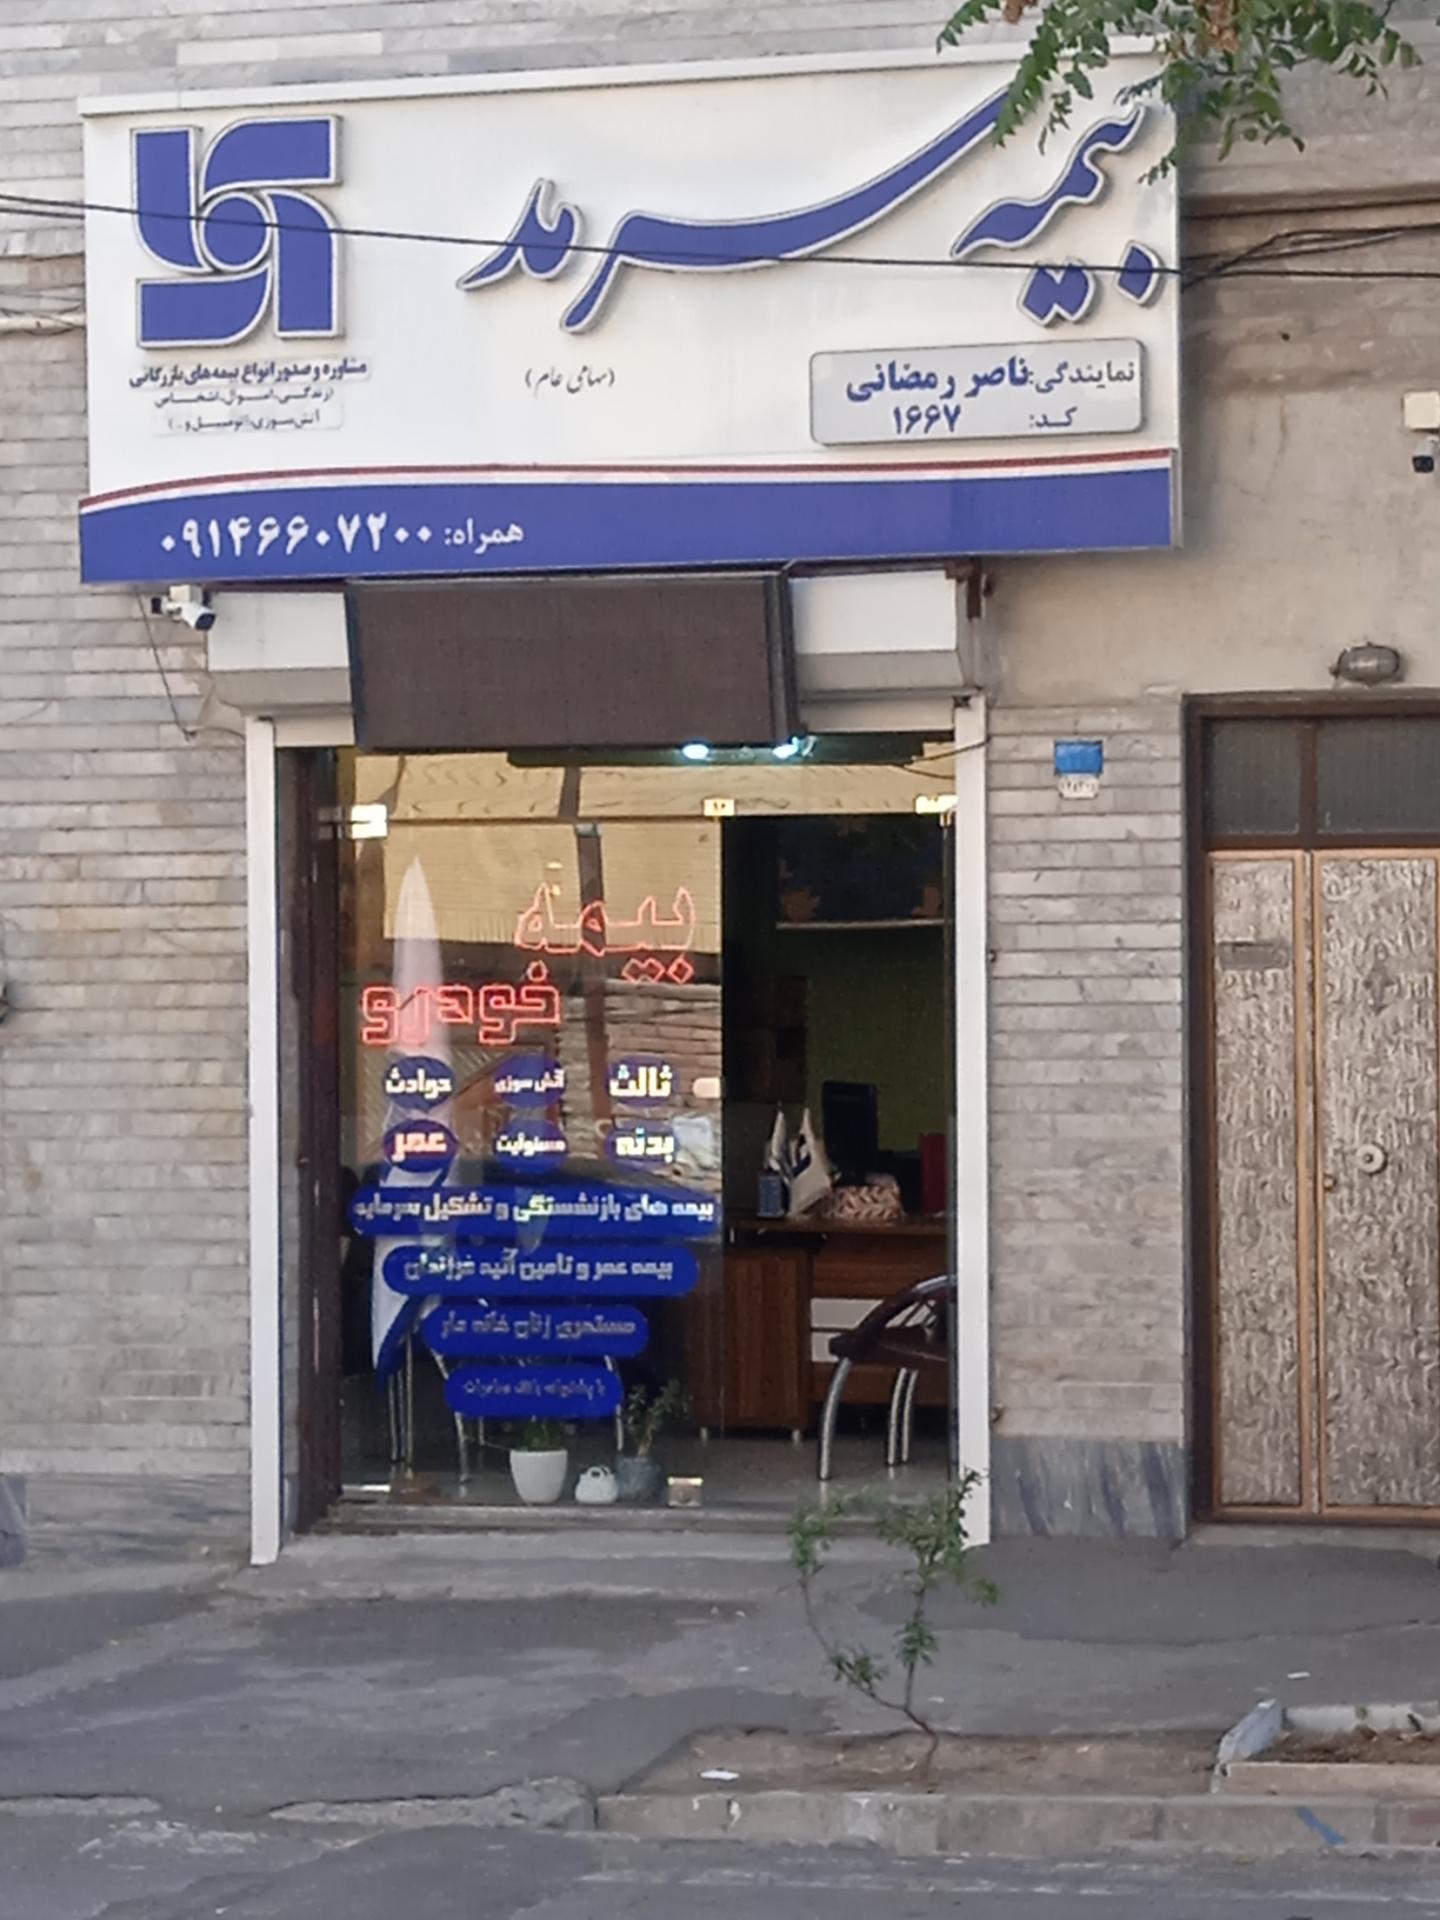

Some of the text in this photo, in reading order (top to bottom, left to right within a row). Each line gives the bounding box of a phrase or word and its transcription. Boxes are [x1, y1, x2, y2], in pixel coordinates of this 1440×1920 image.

[847, 361, 956, 402] رمضانی
[964, 356, 1029, 398] ناصر
[893, 403, 961, 434] ۱۶۶۷
[161, 511, 524, 558] همراه: ۰۹۱۴۶۶۰۷۲۰۰
[513, 881, 696, 983] بیمه
[362, 960, 561, 1044] خودرو
[385, 1068, 452, 1099] حوادث
[609, 1065, 673, 1098] ثالث
[391, 1132, 448, 1162] عمر
[616, 1127, 675, 1163] بدنه
[355, 1192, 714, 1222] بیمه های بازنشستگی و تشکیل سرمایه
[576, 1261, 589, 1281] و
[593, 1261, 628, 1281] عمر
[632, 1261, 673, 1281] بیمه
